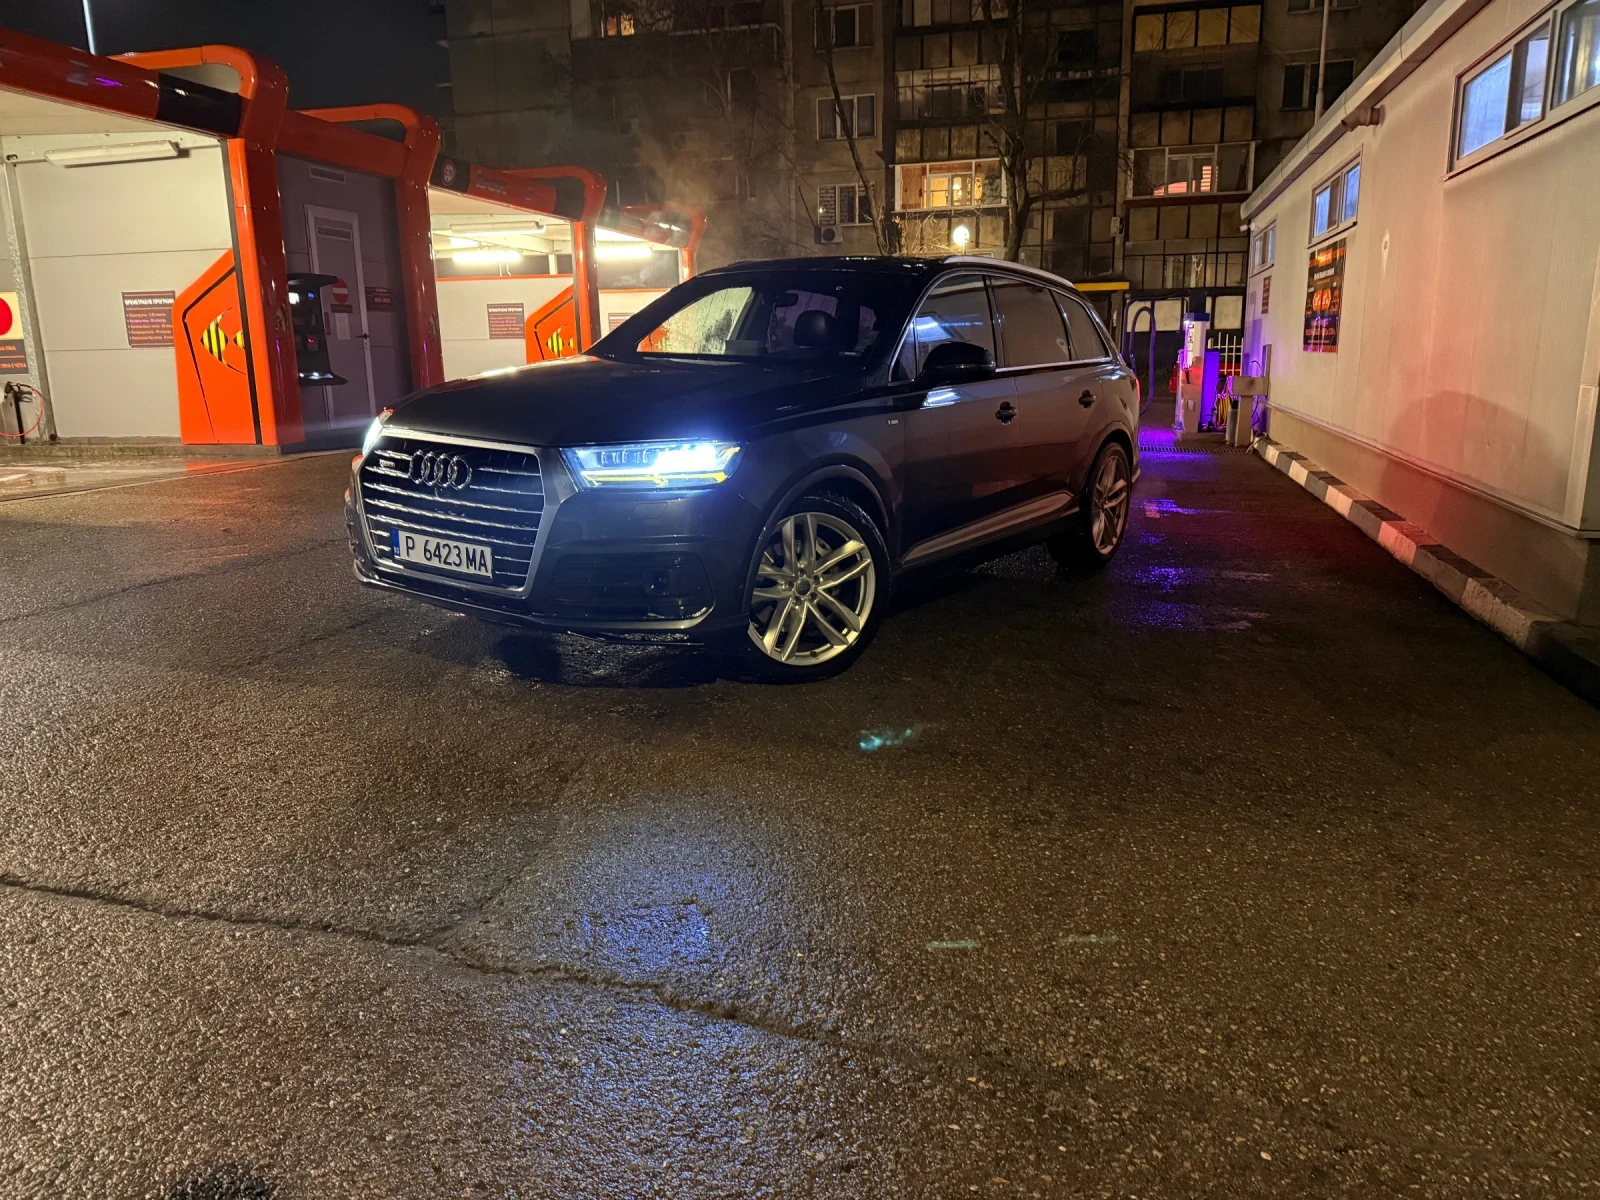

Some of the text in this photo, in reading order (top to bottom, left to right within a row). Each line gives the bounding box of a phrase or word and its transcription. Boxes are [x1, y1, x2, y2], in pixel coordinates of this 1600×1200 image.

[404, 535, 489, 574] P 6423 MA
